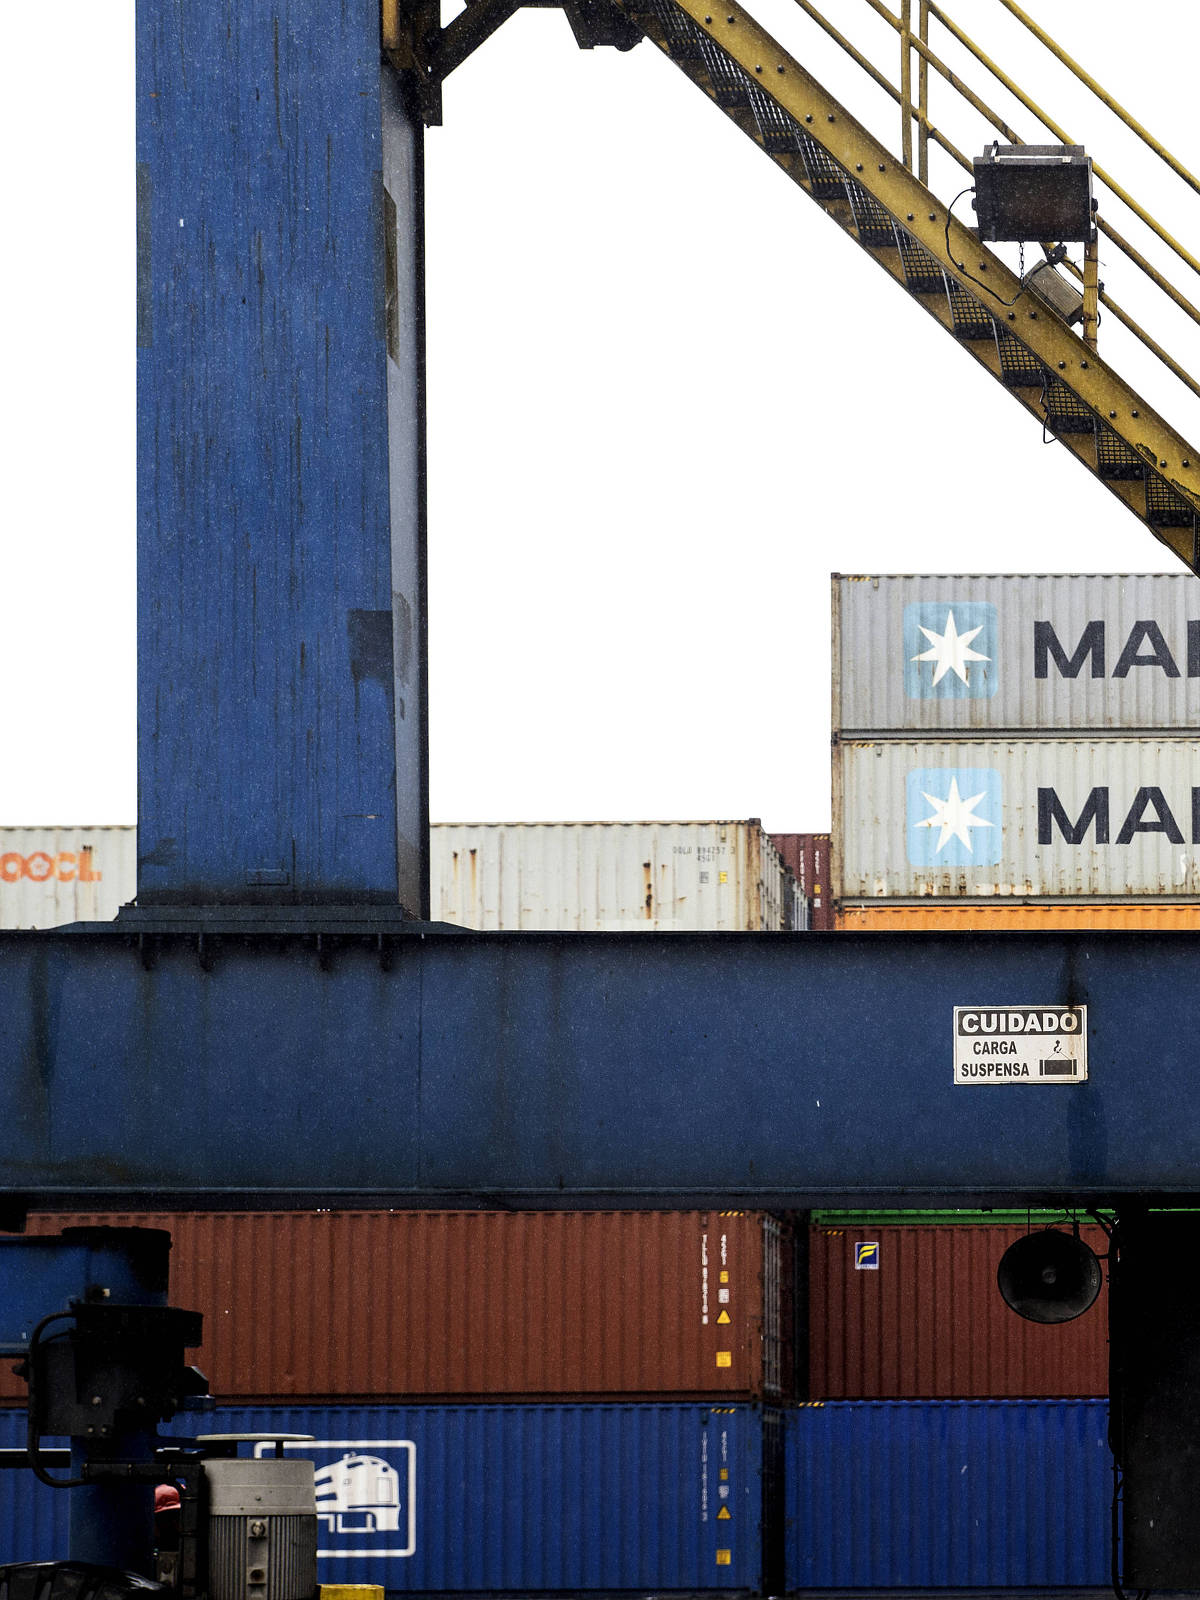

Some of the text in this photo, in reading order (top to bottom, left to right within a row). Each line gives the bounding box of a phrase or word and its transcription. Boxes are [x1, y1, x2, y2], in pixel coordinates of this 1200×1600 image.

[0, 851, 102, 883] OOCL
[962, 1013, 1078, 1033] CUIDADO
[973, 1041, 1017, 1055] CARGA
[961, 1062, 1030, 1077] SUSPENSA
